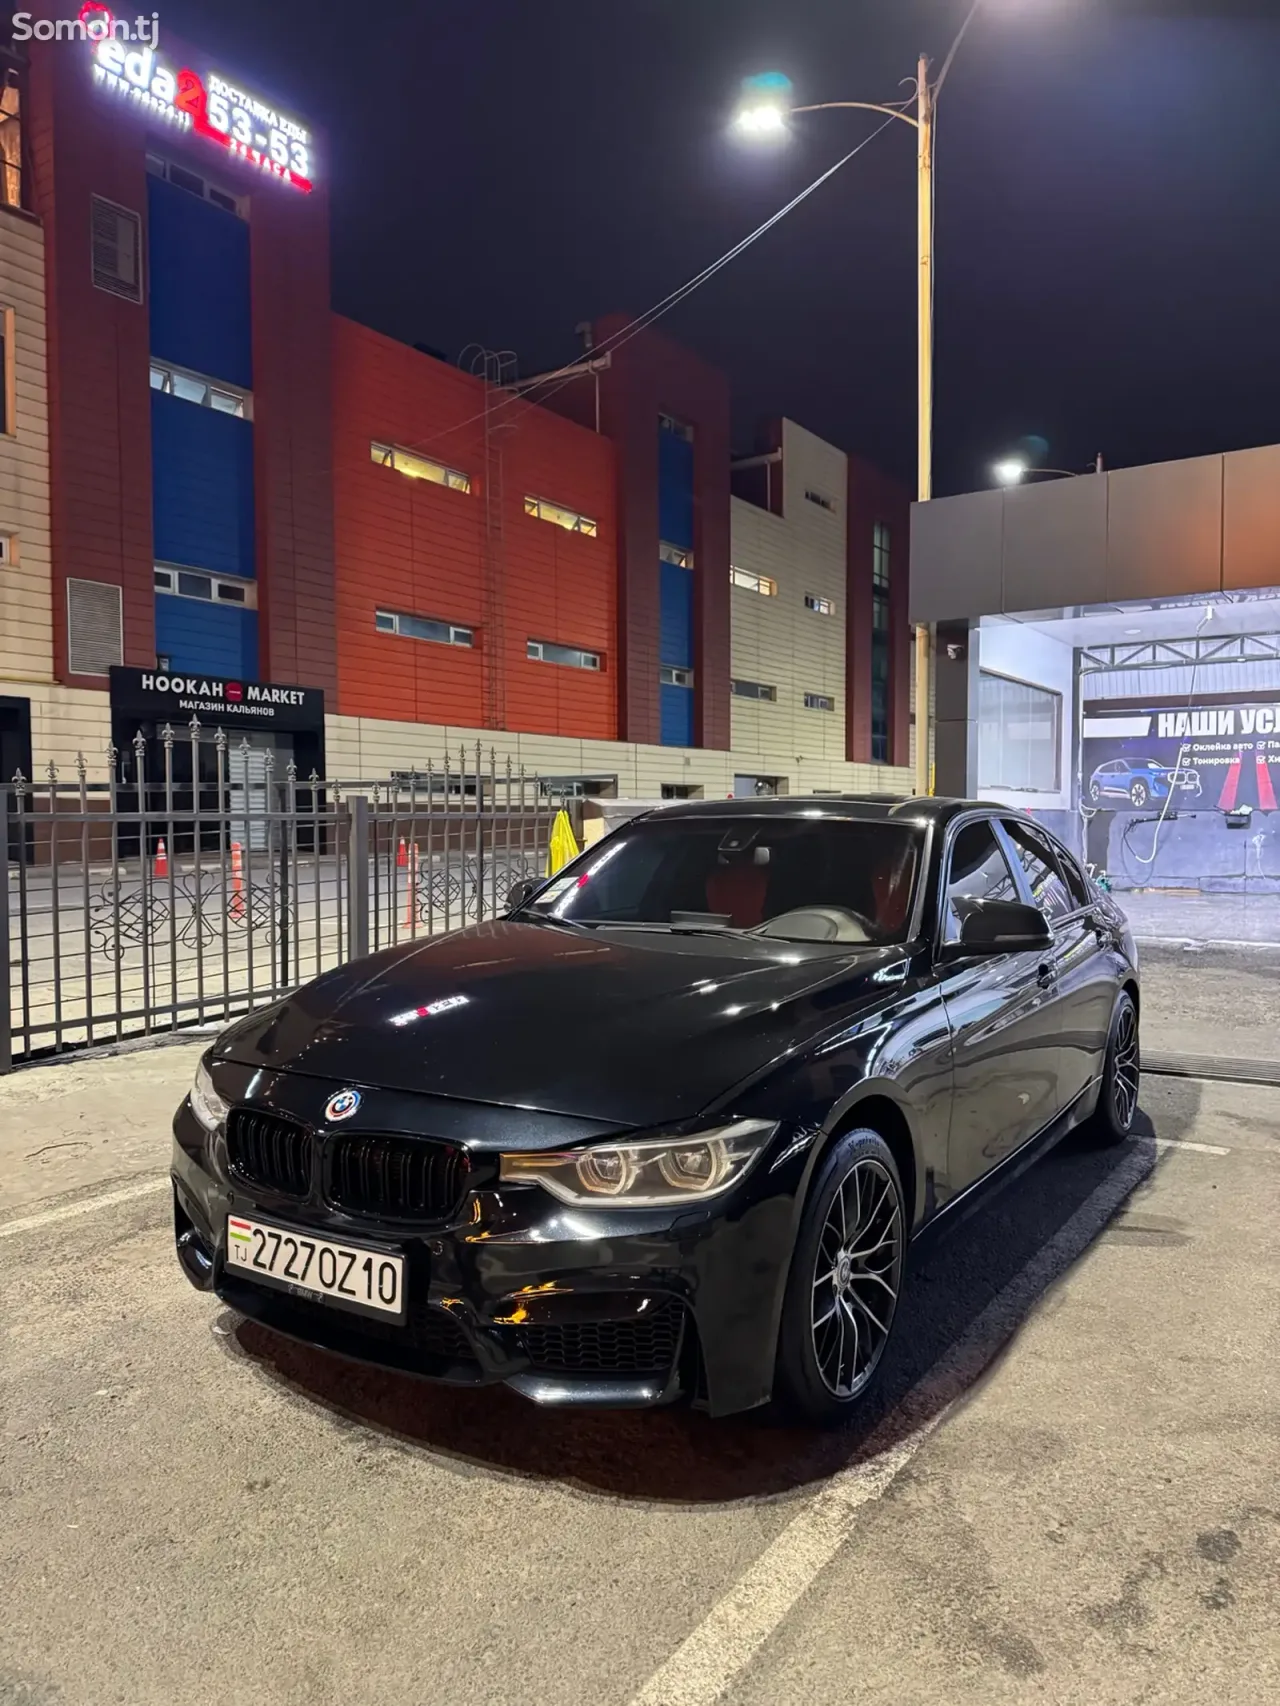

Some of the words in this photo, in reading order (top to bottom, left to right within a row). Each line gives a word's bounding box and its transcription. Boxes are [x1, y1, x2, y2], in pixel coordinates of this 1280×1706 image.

[208, 93, 309, 178] 53-53
[142, 674, 224, 697] HOOKAH
[247, 686, 304, 706] MARKET
[179, 699, 225, 713] МАГАЗИН
[226, 703, 275, 716] КАЛЬЯНОВ
[1157, 710, 1235, 738] НАШИ
[1193, 742, 1230, 752] Оклейка
[1233, 742, 1254, 751] авто
[1193, 757, 1240, 766] Тонировка
[234, 1244, 248, 1262] TJ
